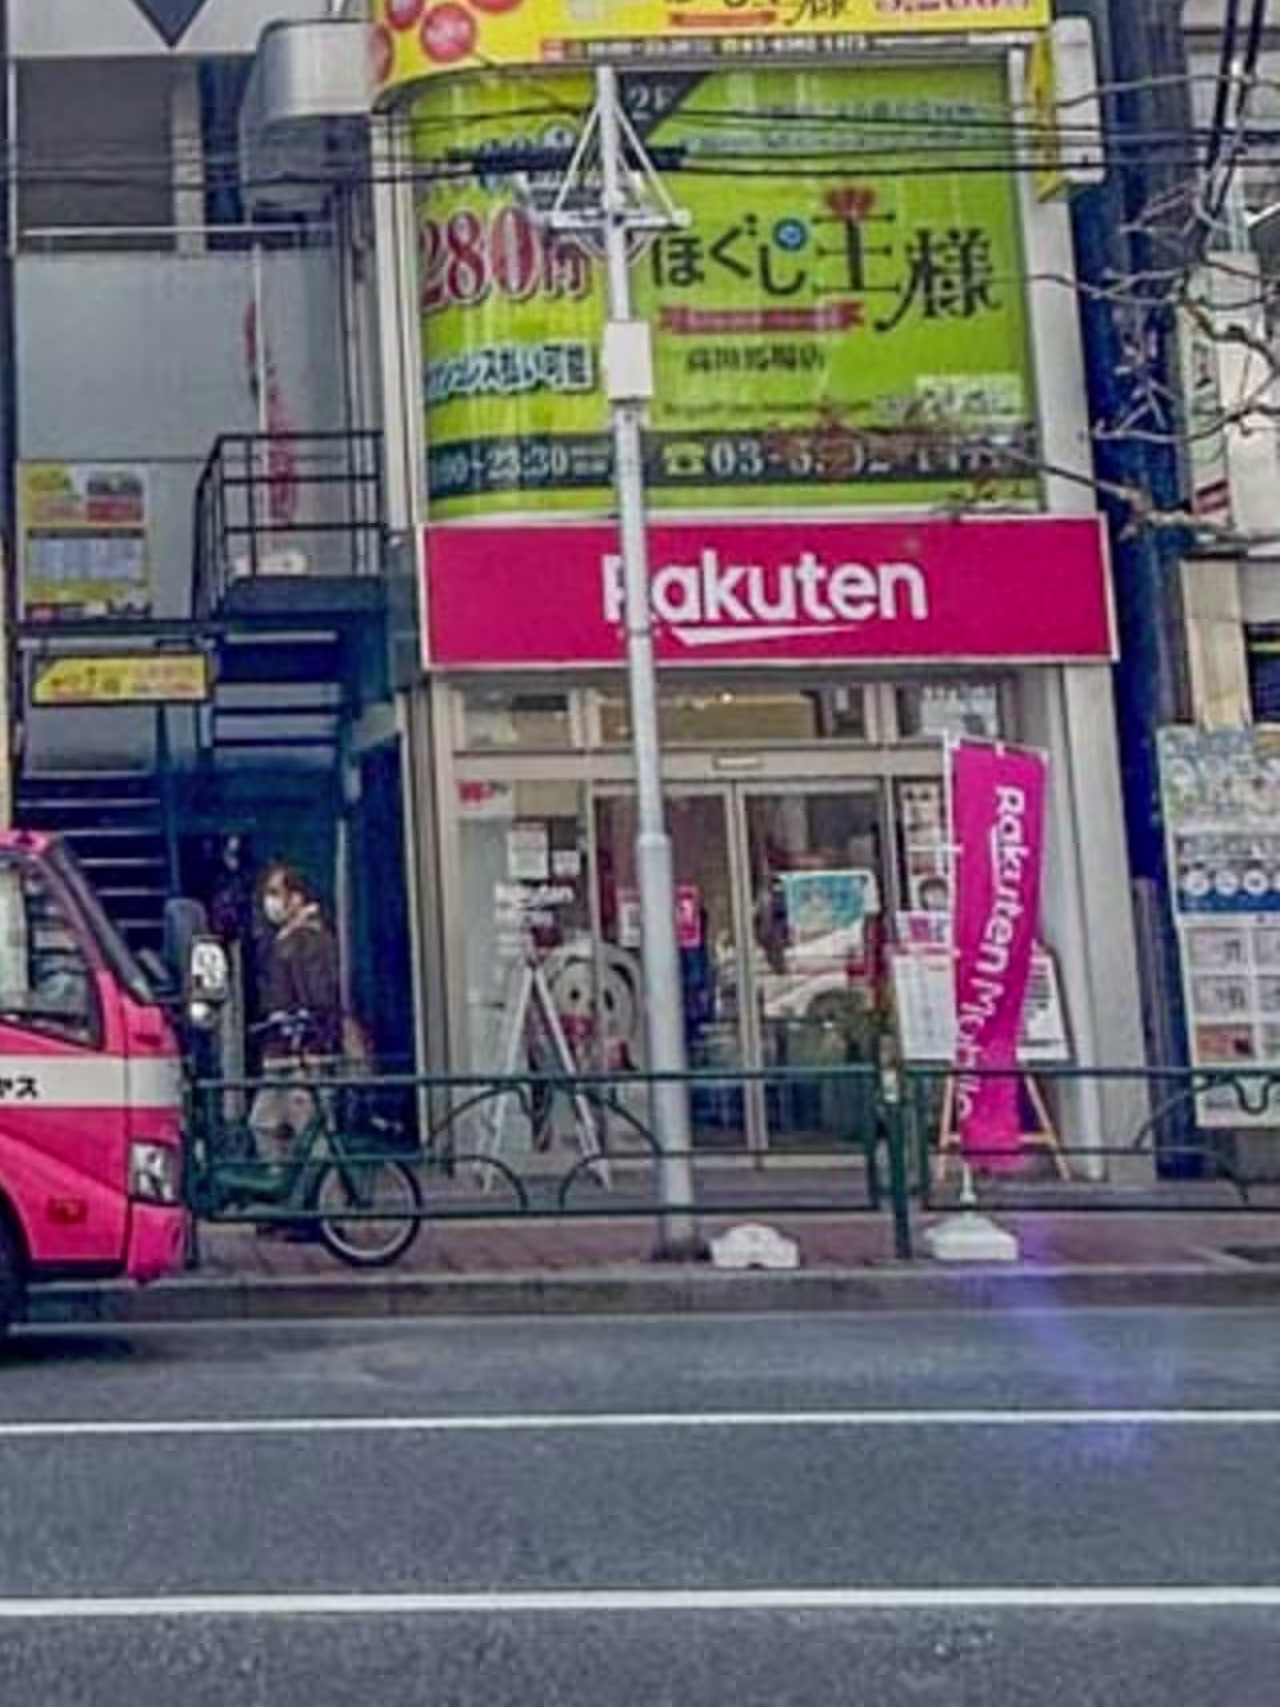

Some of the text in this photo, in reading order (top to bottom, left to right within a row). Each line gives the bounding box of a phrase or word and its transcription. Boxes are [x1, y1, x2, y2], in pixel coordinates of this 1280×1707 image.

[651, 209, 1002, 332] ほぐし王様
